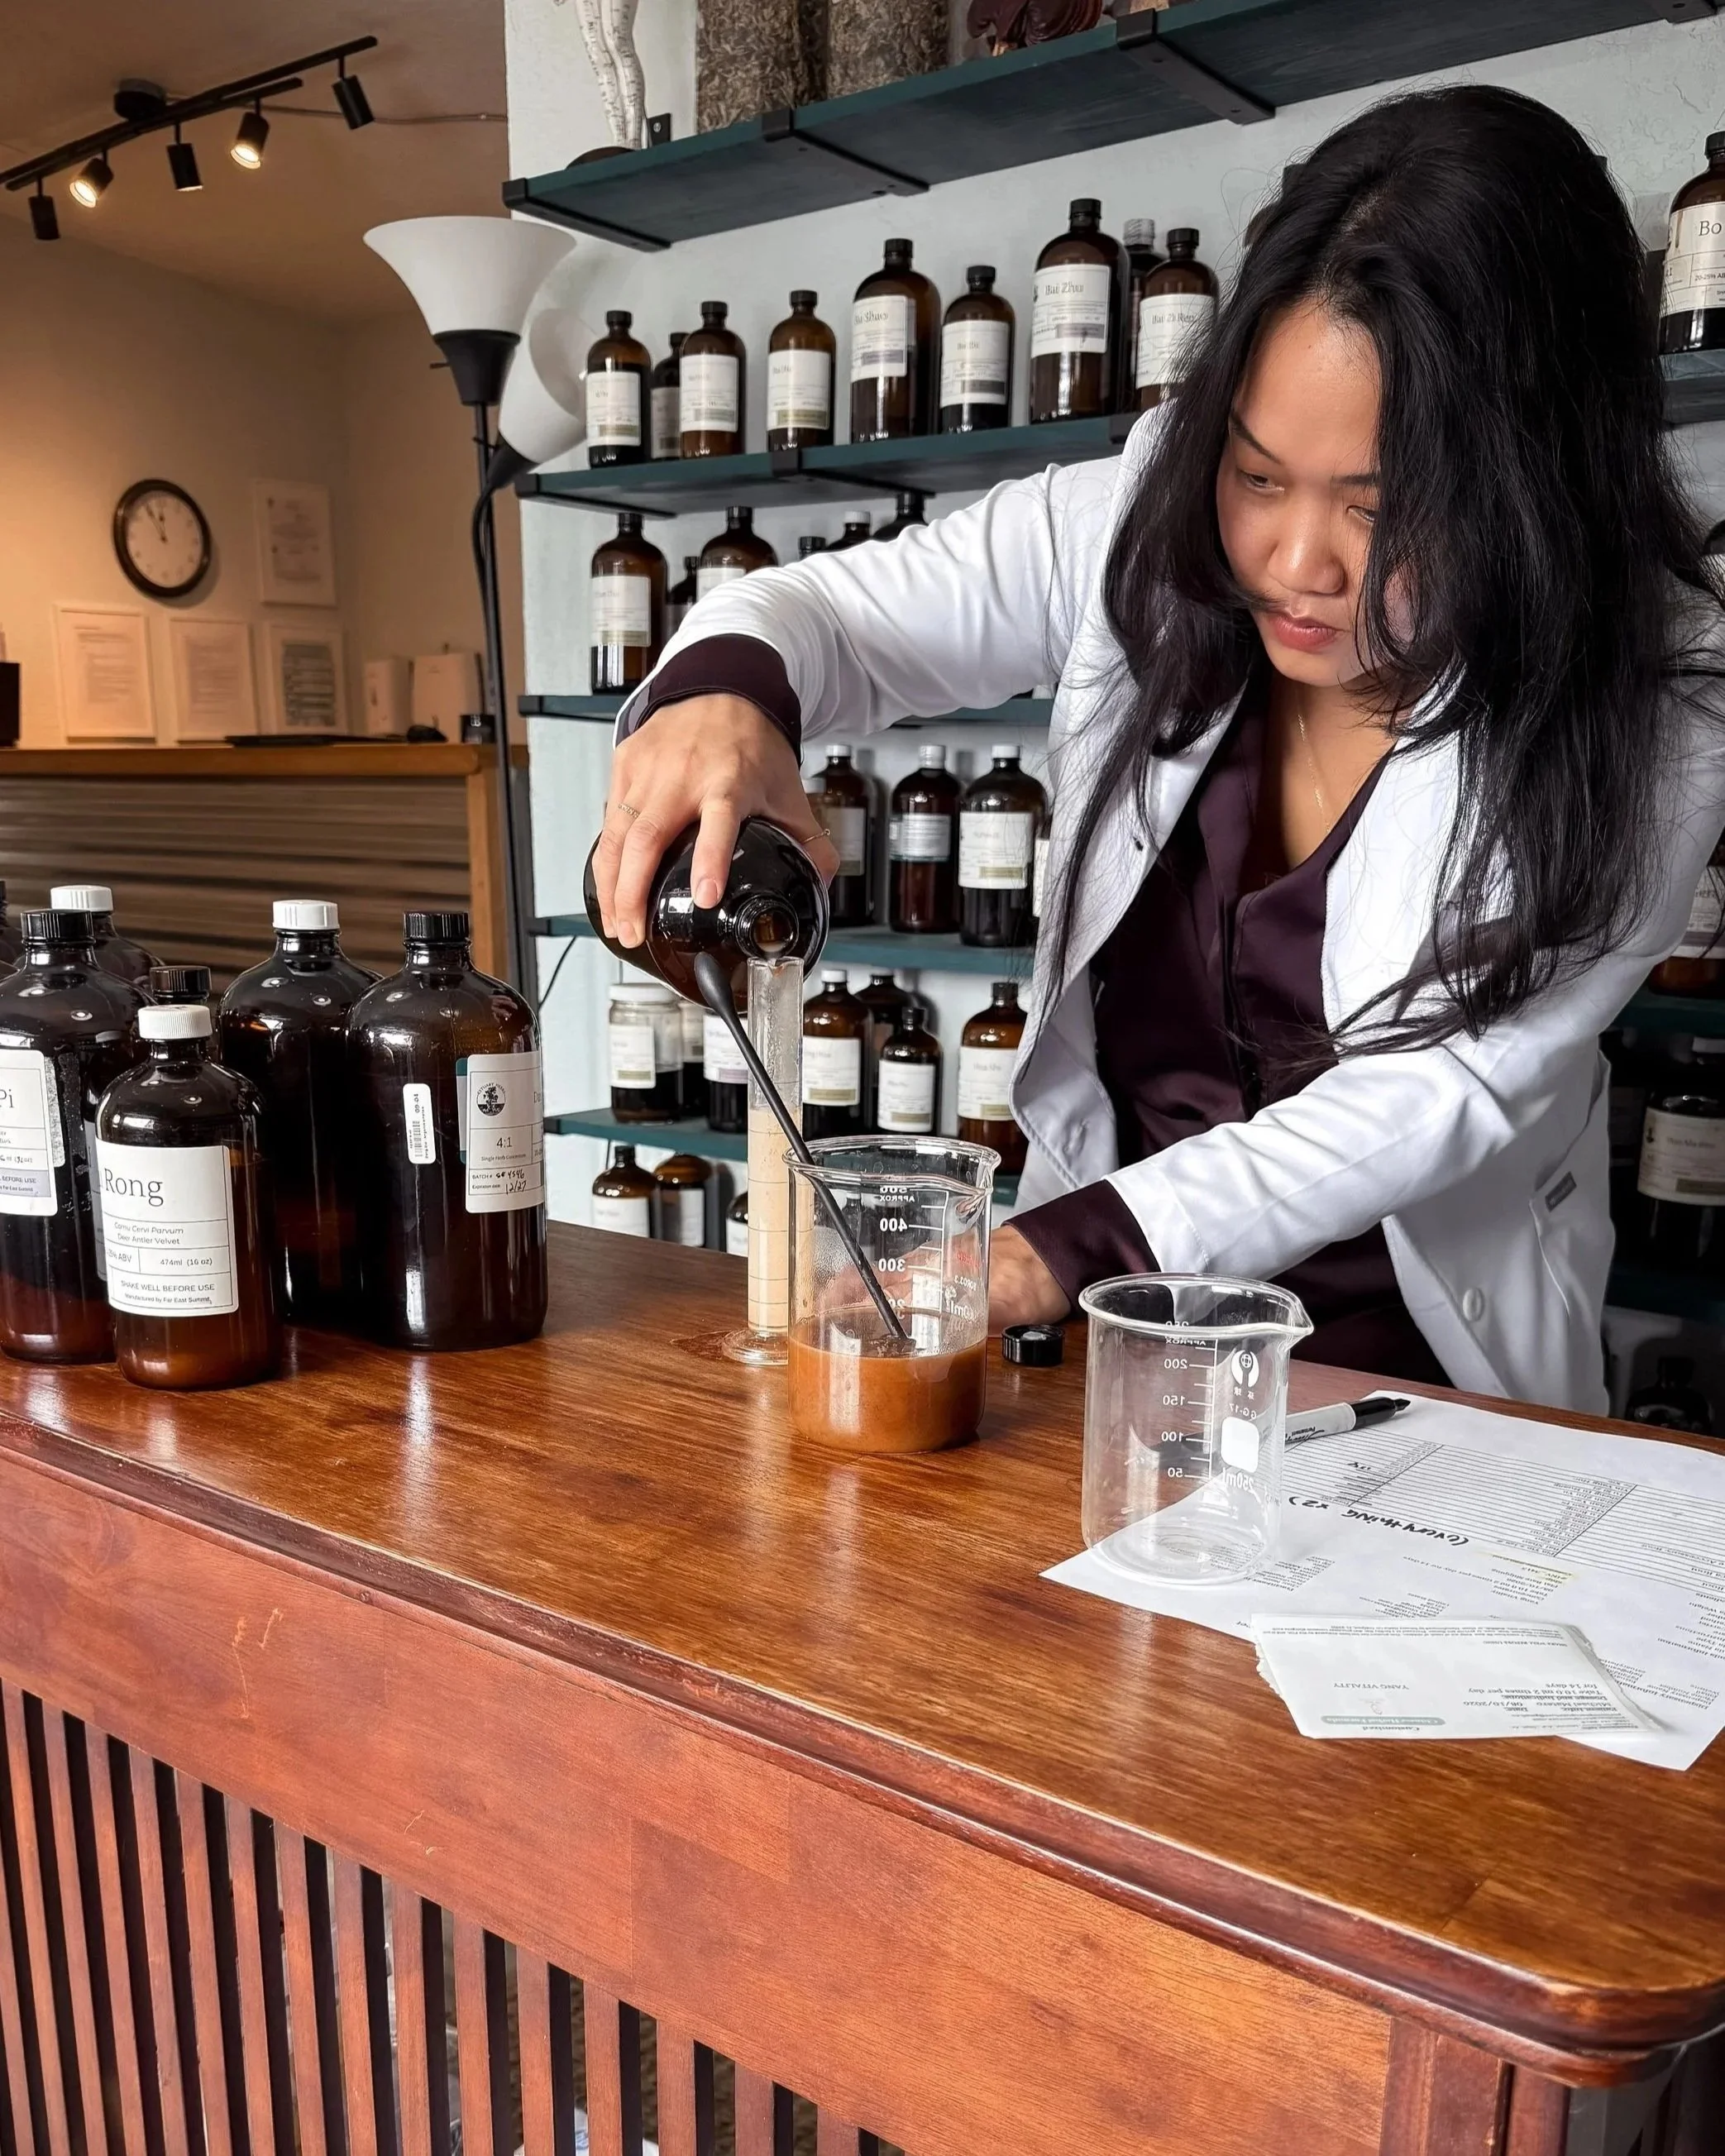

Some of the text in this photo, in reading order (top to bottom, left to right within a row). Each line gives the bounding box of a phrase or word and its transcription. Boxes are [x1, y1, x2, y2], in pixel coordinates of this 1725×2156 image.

[1699, 220, 1723, 237] Bo
[496, 1136, 513, 1148] 4:1
[104, 1168, 164, 1207] Rong
[131, 1225, 150, 1234] Cervi
[151, 1226, 184, 1235] Parvum
[131, 1236, 153, 1244] Antler
[160, 1257, 183, 1266] 474ml
[141, 1283, 161, 1292] WELL
[163, 1284, 196, 1292] BEFORE
